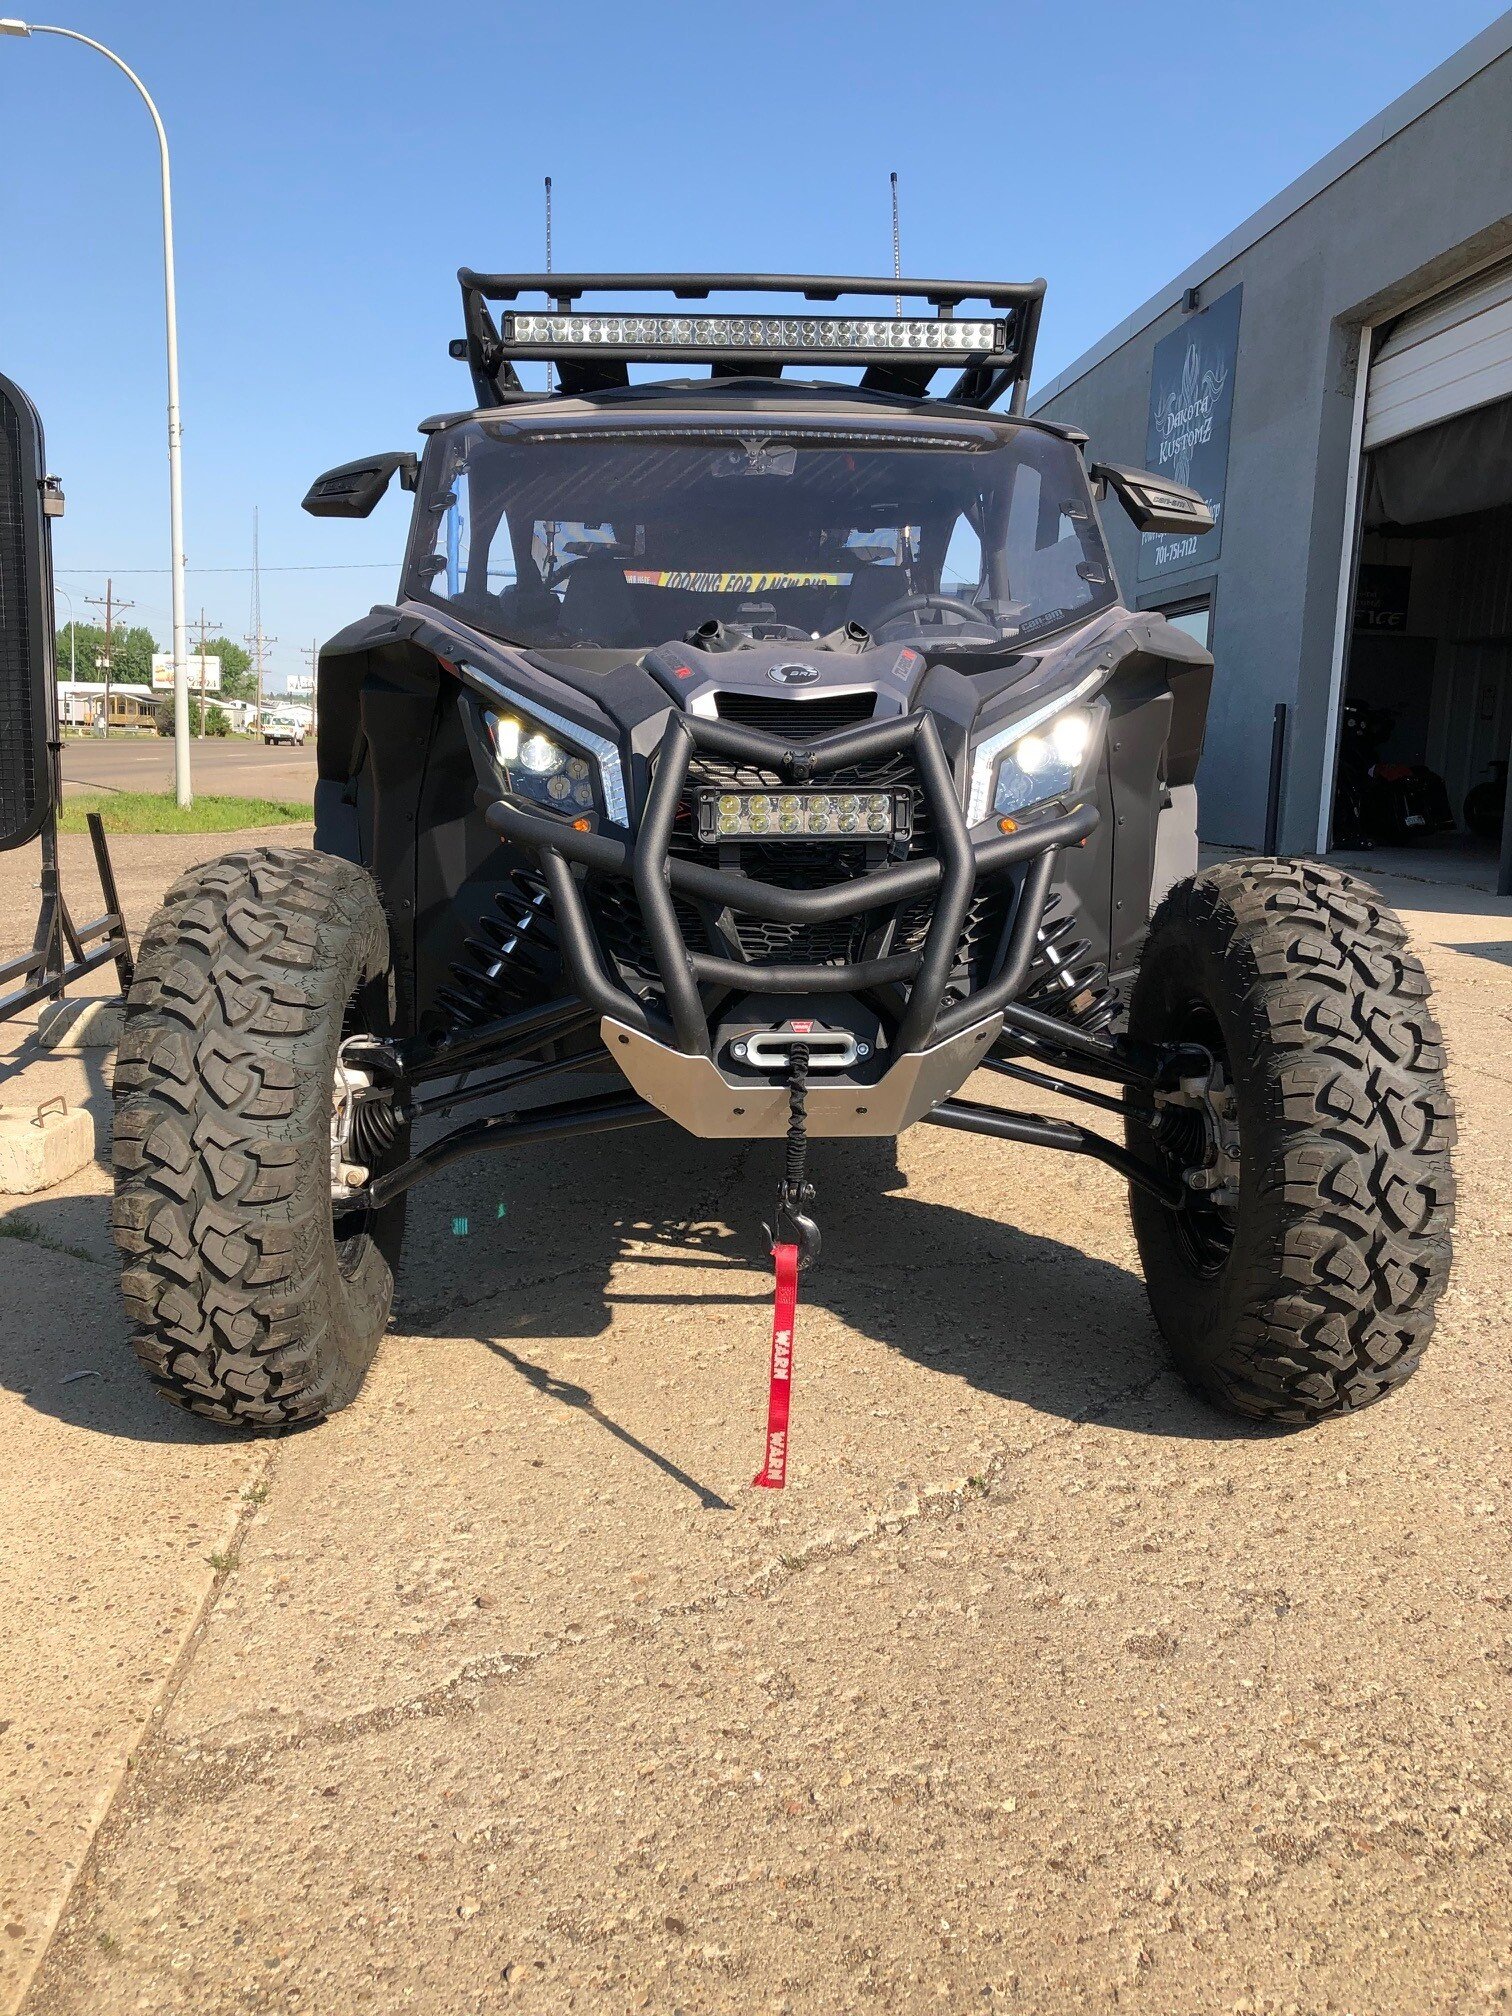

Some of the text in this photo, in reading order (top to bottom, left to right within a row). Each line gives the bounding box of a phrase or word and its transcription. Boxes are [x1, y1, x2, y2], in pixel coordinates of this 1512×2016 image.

[1158, 416, 1213, 465] KUSTOMZ
[1155, 535, 1198, 565] 701-751-7122
[666, 572, 723, 591] LOOKING
[724, 575, 753, 592] FOR
[773, 1329, 791, 1380] WARN
[768, 1431, 785, 1480] WARN
